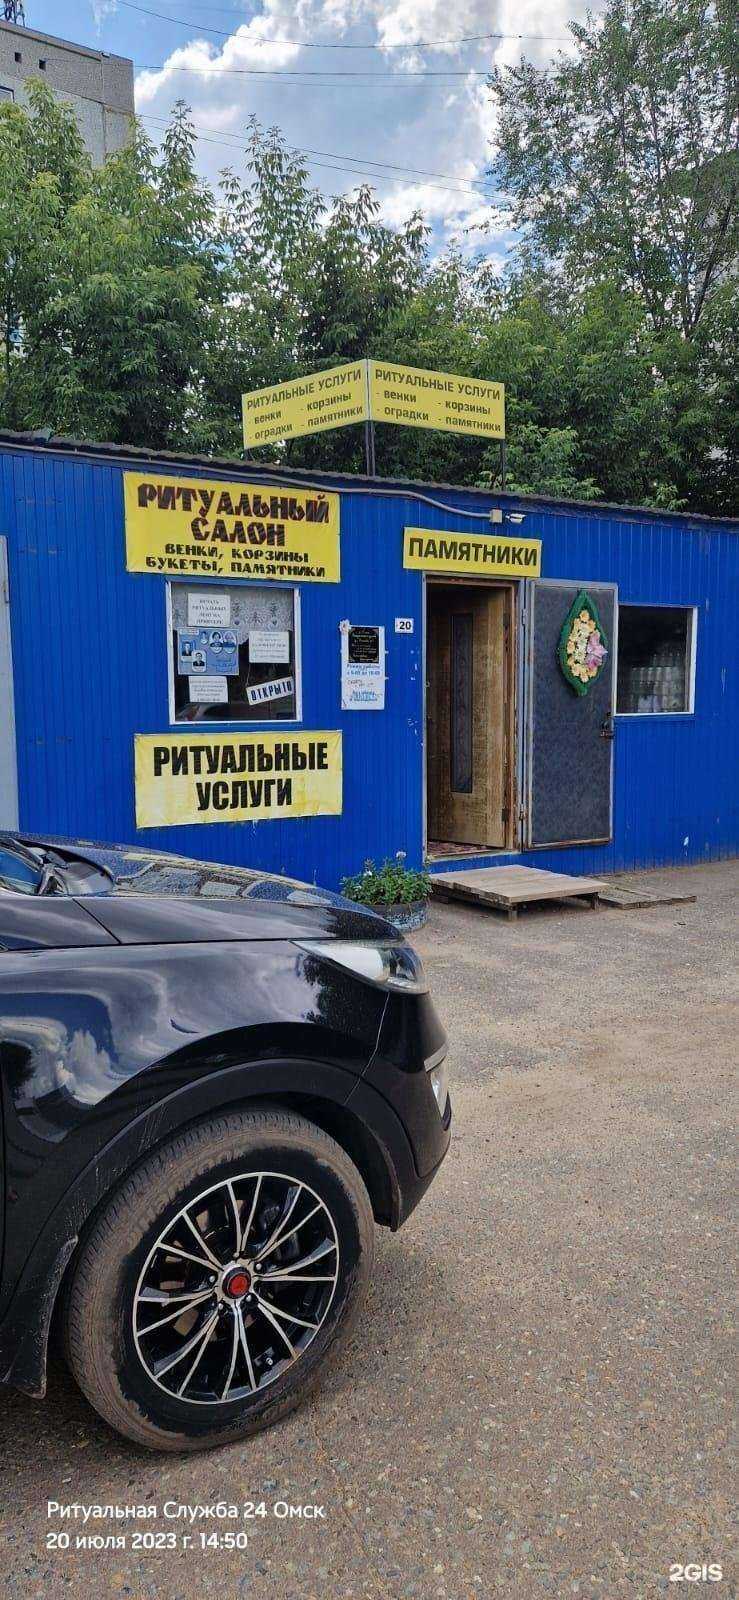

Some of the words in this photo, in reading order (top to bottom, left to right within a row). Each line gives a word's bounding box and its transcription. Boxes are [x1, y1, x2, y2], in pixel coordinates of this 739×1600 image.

[247, 384, 315, 411] РИТУАЛЬНЫЕ
[318, 369, 362, 391] УСЛУГИ
[375, 369, 454, 393] РИТУАЛЬНЫЕ
[457, 384, 501, 401] УСЛУГИ
[254, 410, 282, 425] венки
[307, 393, 352, 413] корзины
[384, 390, 417, 404] венки
[445, 400, 491, 416] корзины
[254, 423, 293, 441] оградки
[307, 406, 363, 428] памятники
[384, 407, 429, 422] оградки
[445, 416, 501, 433] памятники
[138, 483, 330, 523] РИТУАЛЬНЫЙ
[191, 517, 285, 547] САЛОН
[146, 556, 223, 574] БУКЕТЫ,
[230, 562, 325, 577] ПАМЯТНИКИ
[165, 543, 224, 559] ВЕНКИ,
[232, 548, 309, 563] КОРЗИНЫ
[409, 537, 538, 566] ПАМЯТНИКИ
[399, 621, 412, 630] 20
[250, 680, 293, 701] ОТКРЫТО
[153, 743, 328, 776] РИТУАЛЬНЫЕ
[196, 778, 292, 811] УСЛУГИ
